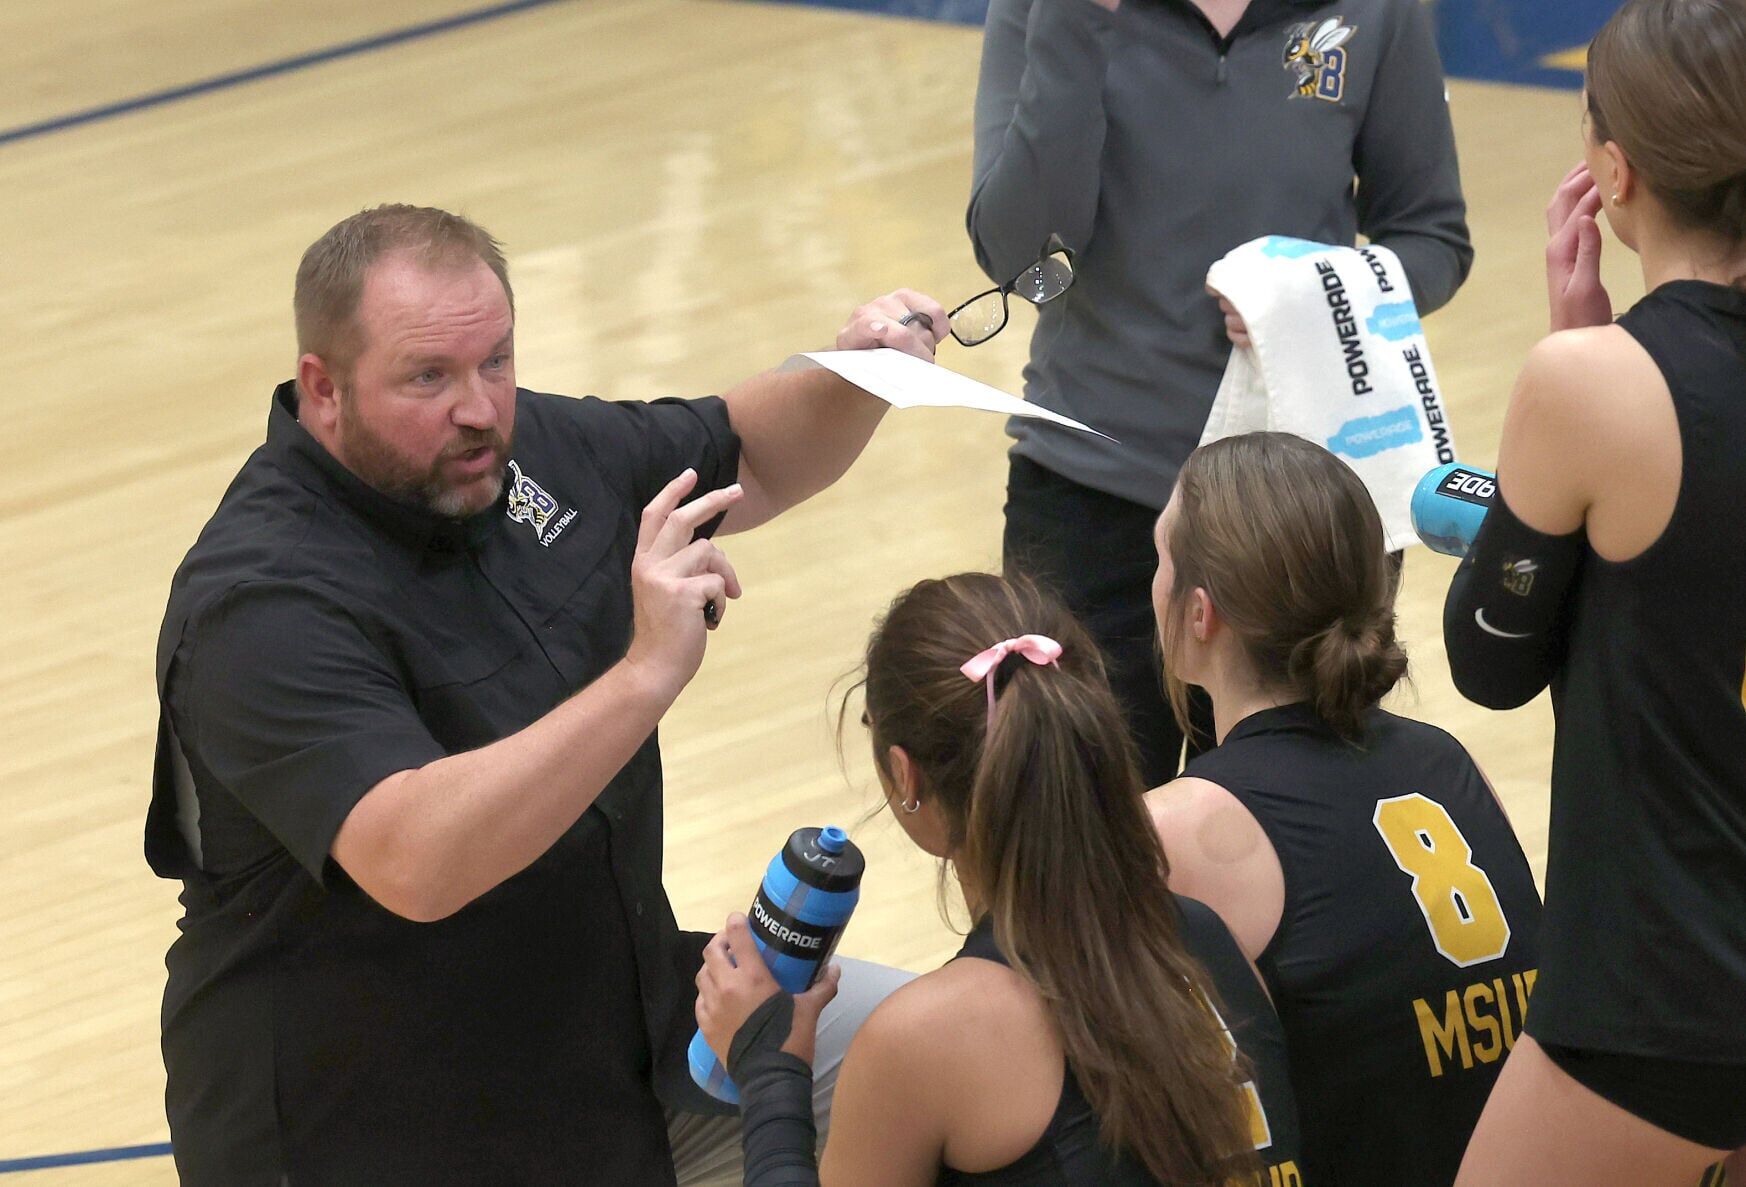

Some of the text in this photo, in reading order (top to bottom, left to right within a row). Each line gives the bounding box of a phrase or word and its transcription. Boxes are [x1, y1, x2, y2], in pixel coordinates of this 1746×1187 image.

[1315, 258, 1373, 395] POWERADE
[1402, 344, 1454, 464] OWERADE
[540, 508, 578, 547] VOLLEYBALL
[1446, 472, 1496, 498] ADE
[753, 896, 822, 949] POWERADE
[1373, 792, 1511, 968] 8
